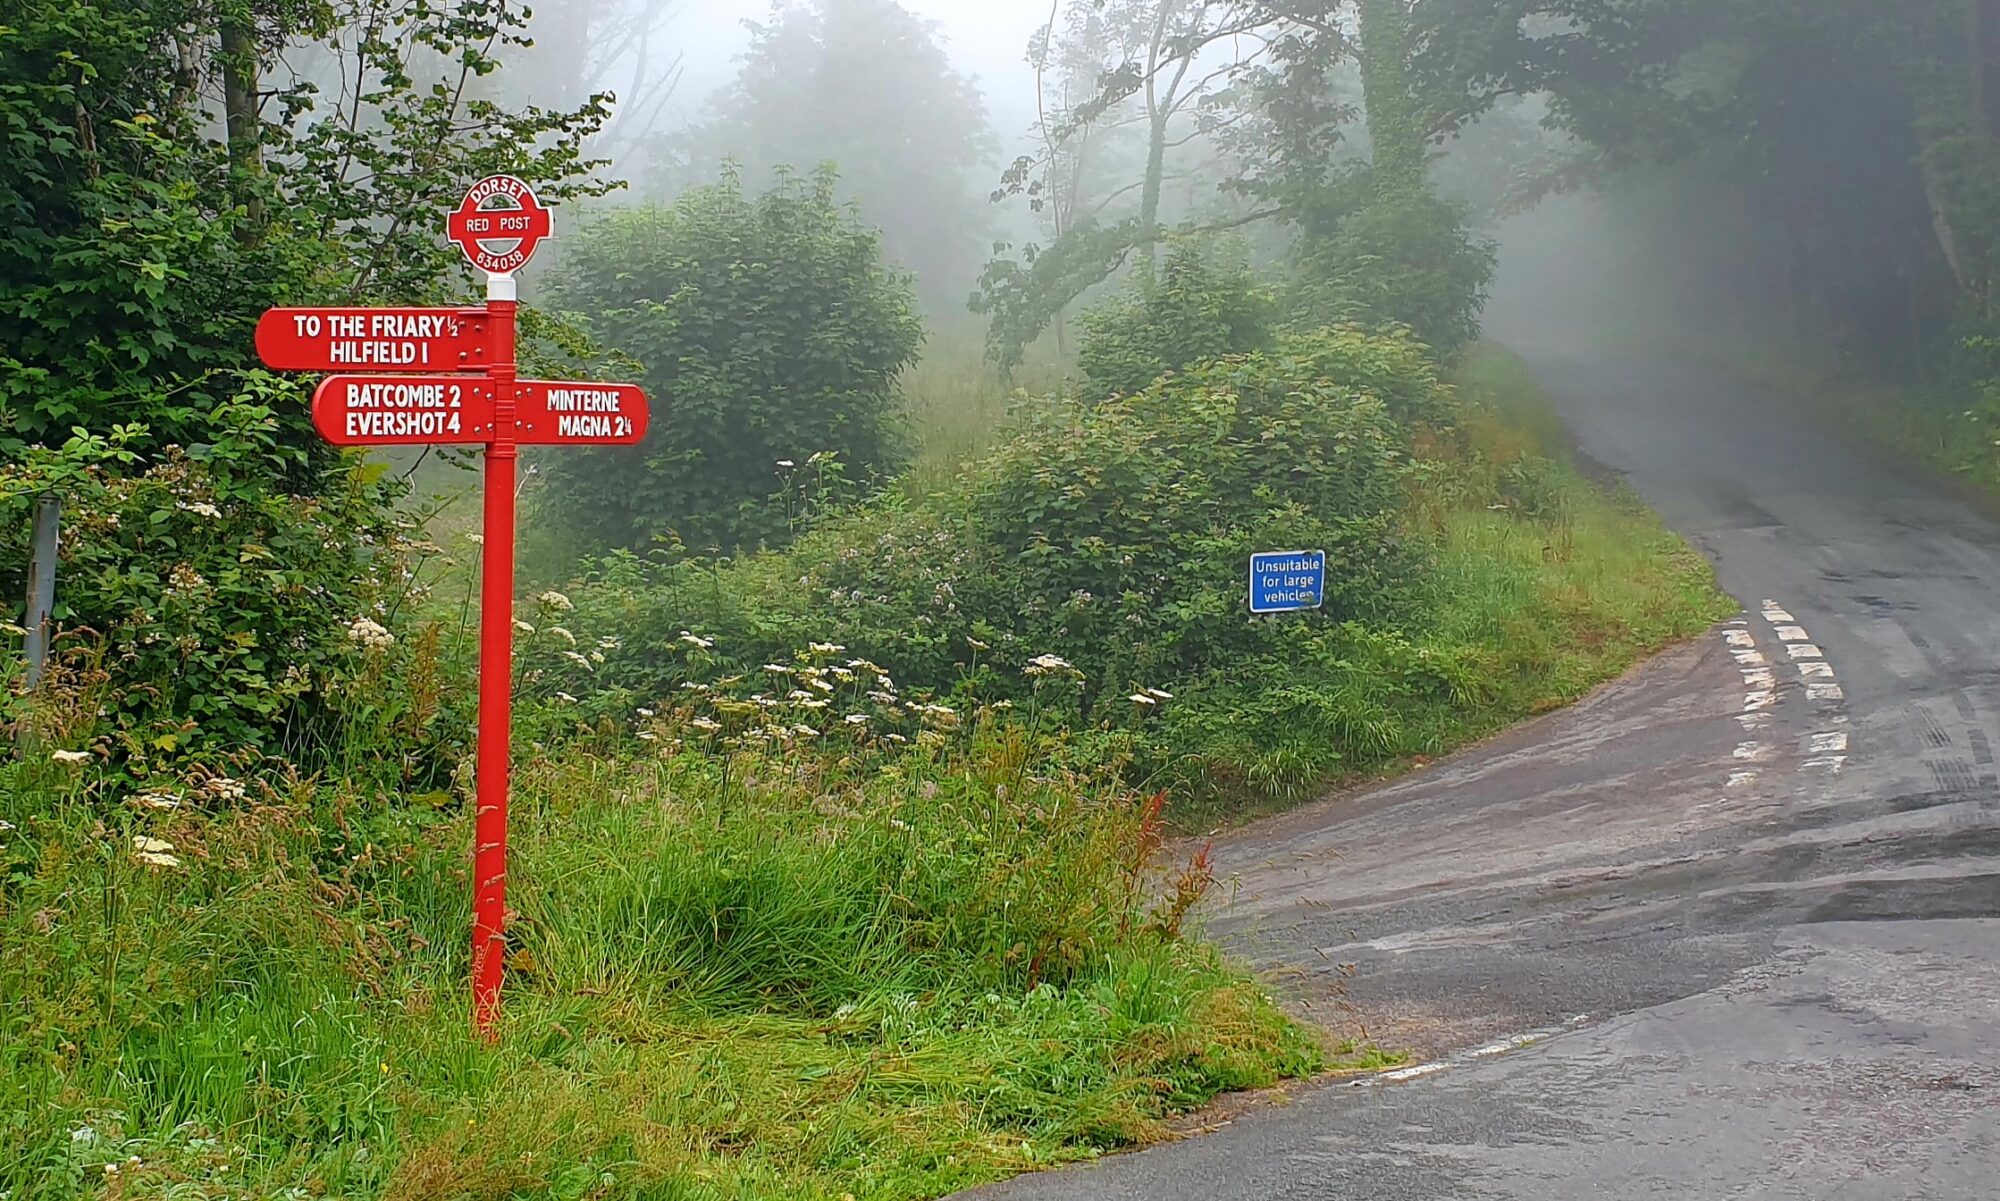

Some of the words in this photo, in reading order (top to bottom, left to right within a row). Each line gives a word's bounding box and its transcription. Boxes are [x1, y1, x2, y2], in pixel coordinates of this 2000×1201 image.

[470, 179, 528, 203] DORSET
[466, 218, 489, 232] RED
[500, 216, 530, 230] POST
[476, 250, 524, 271] 634038
[294, 315, 321, 337] TO
[327, 315, 366, 337] THE
[372, 315, 445, 337] FRIARY
[330, 341, 416, 364] HILFIELD
[346, 383, 445, 408] BATCOMBE
[449, 385, 461, 408] 2
[547, 389, 620, 412] MINTERNE
[346, 412, 446, 436] EVERSHOT
[446, 412, 461, 434] 4
[558, 415, 611, 437] MAGNA
[1256, 557, 1319, 573] Unsuitable
[1263, 575, 1280, 588] for
[1284, 574, 1314, 588] large
